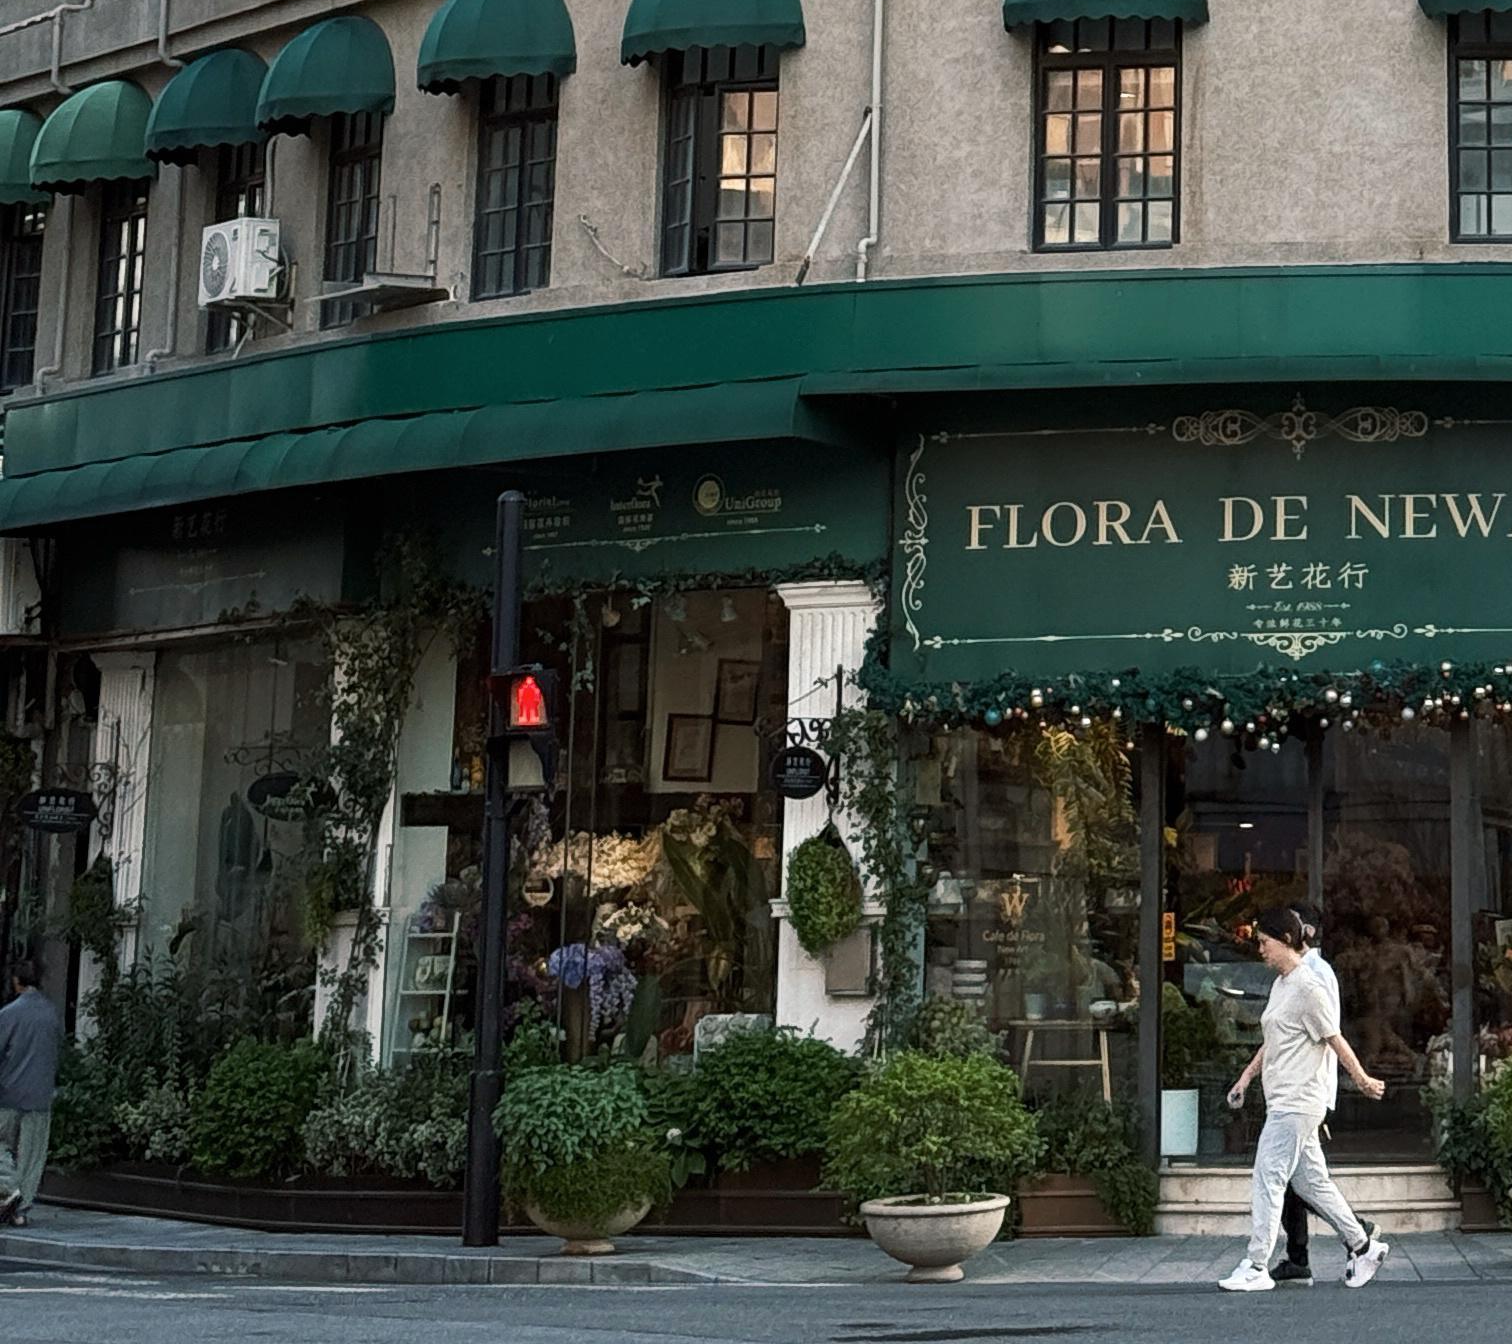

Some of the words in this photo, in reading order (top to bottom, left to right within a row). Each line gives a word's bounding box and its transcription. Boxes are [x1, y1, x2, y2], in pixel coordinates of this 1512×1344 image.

[725, 495, 782, 511] UniGroup
[964, 499, 1184, 550] FLORA
[1218, 495, 1309, 542] DE
[1227, 561, 1370, 592] 新艺花行
